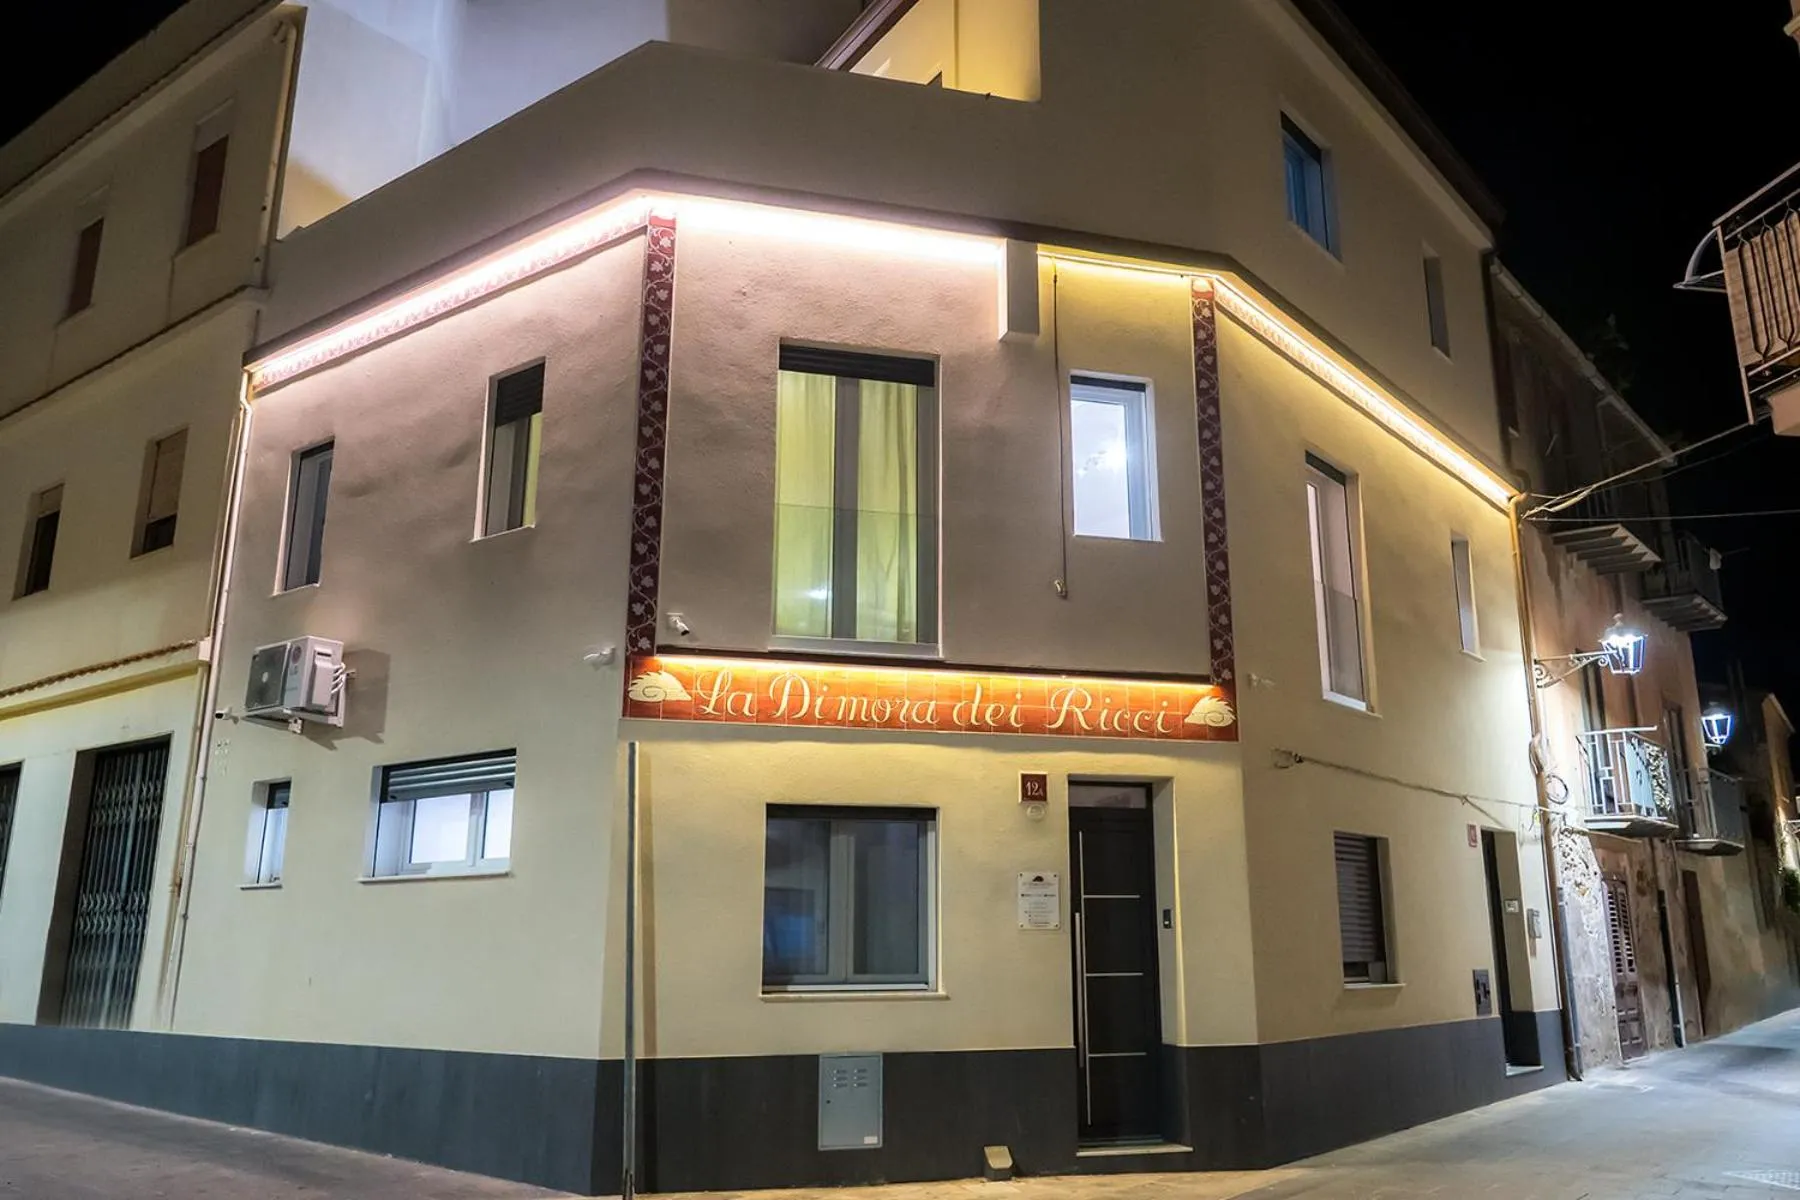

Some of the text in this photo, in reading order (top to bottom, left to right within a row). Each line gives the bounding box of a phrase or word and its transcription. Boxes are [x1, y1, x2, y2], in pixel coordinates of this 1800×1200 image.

[696, 671, 1172, 733] La Dimora dei Ricci
